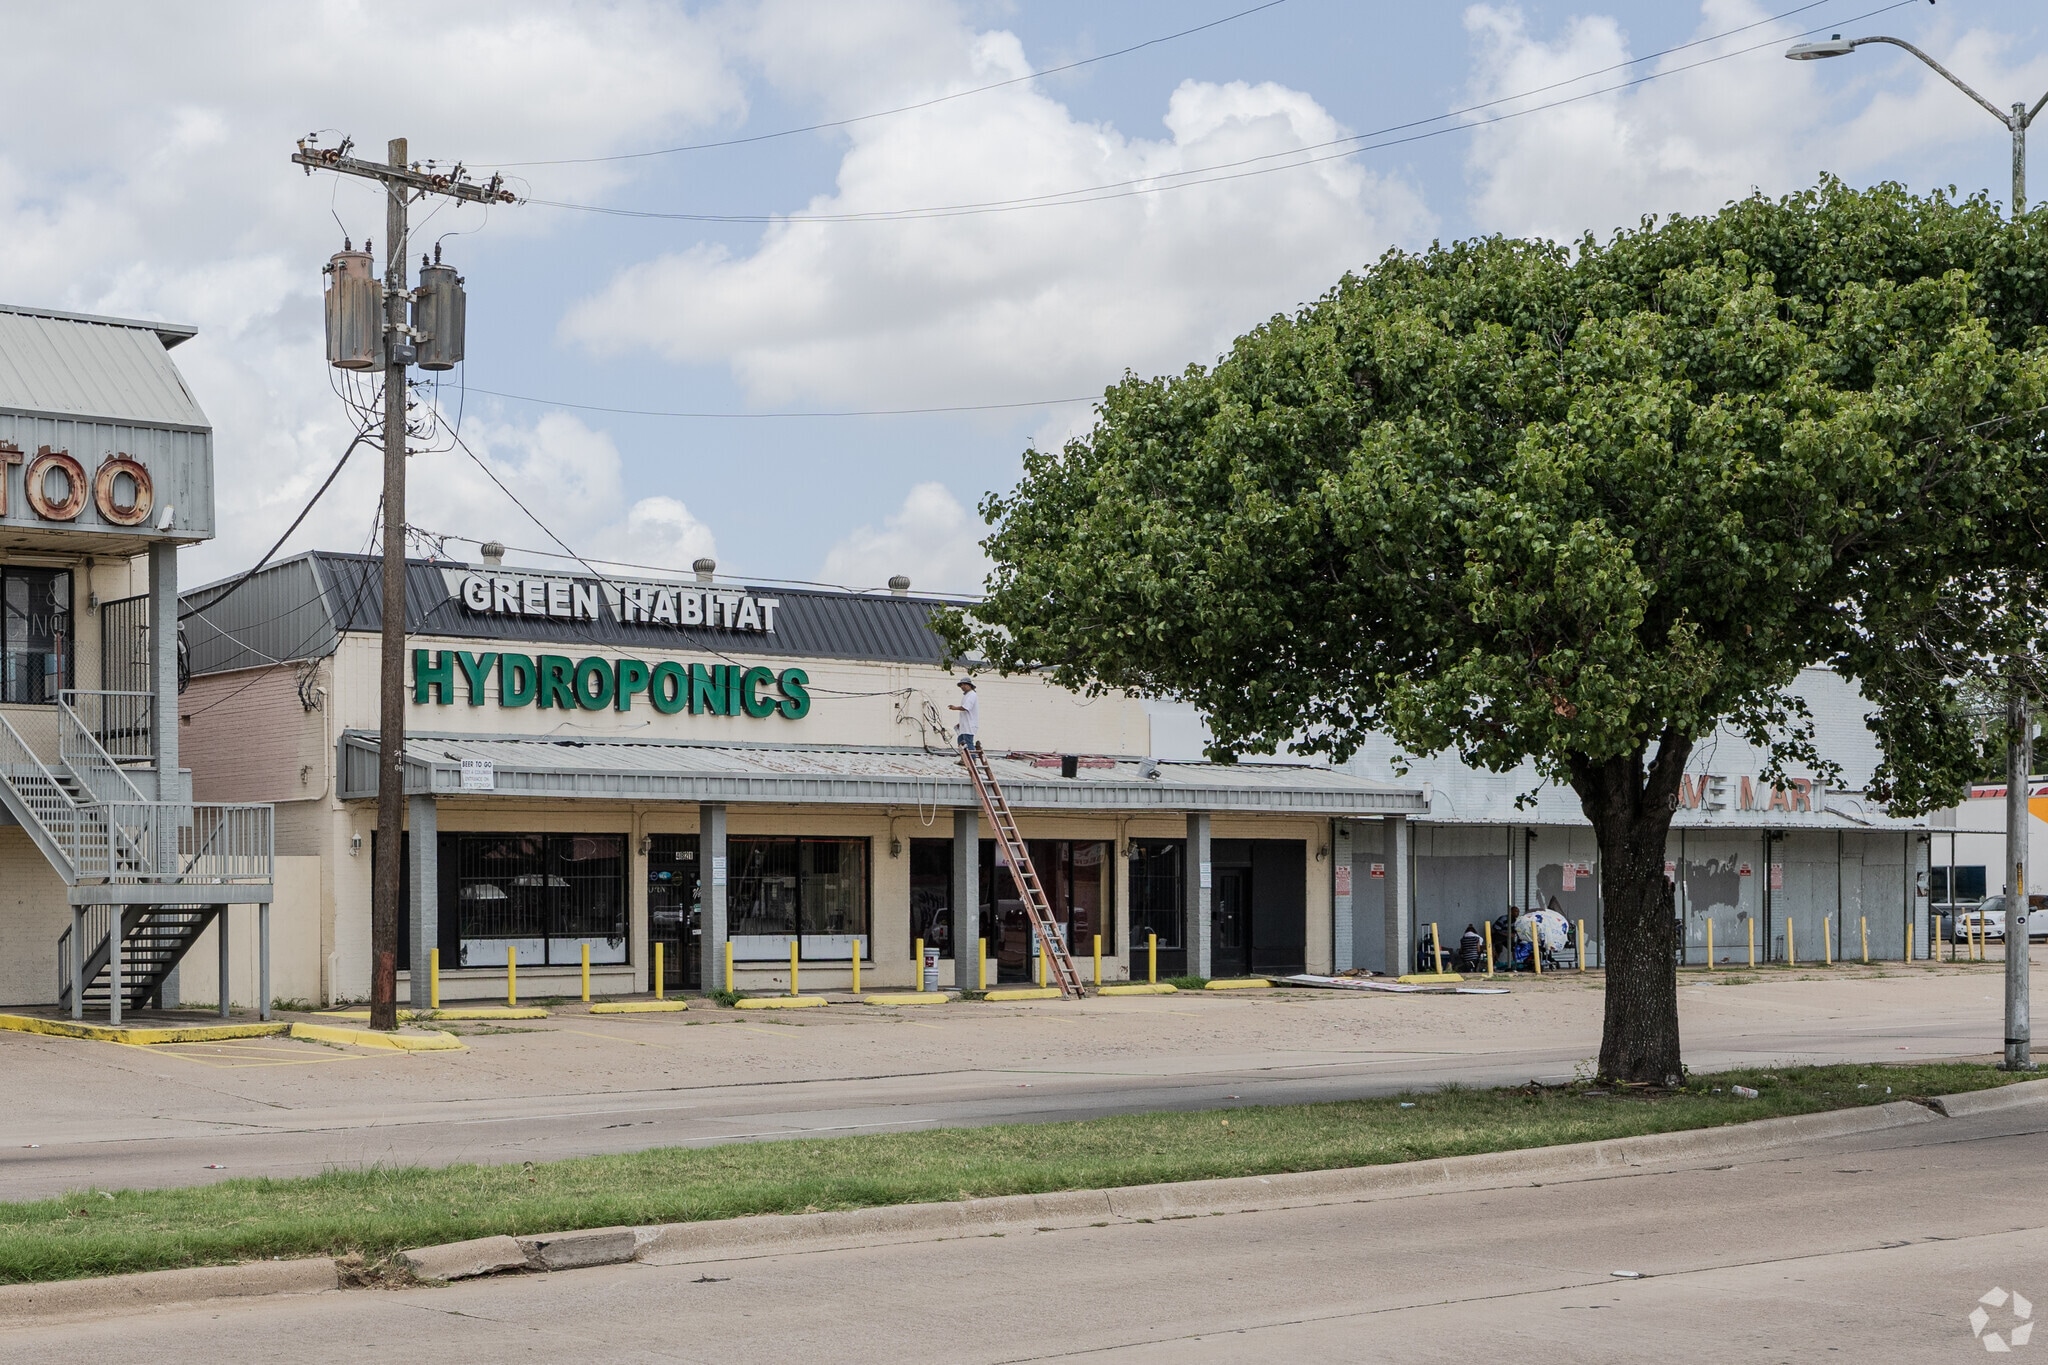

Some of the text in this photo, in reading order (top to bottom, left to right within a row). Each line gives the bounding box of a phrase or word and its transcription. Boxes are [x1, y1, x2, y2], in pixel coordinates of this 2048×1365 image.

[460, 575, 779, 631] GREEN HABITAT
[413, 649, 811, 720] HYDROPONICS
[462, 760, 474, 768] BEER
